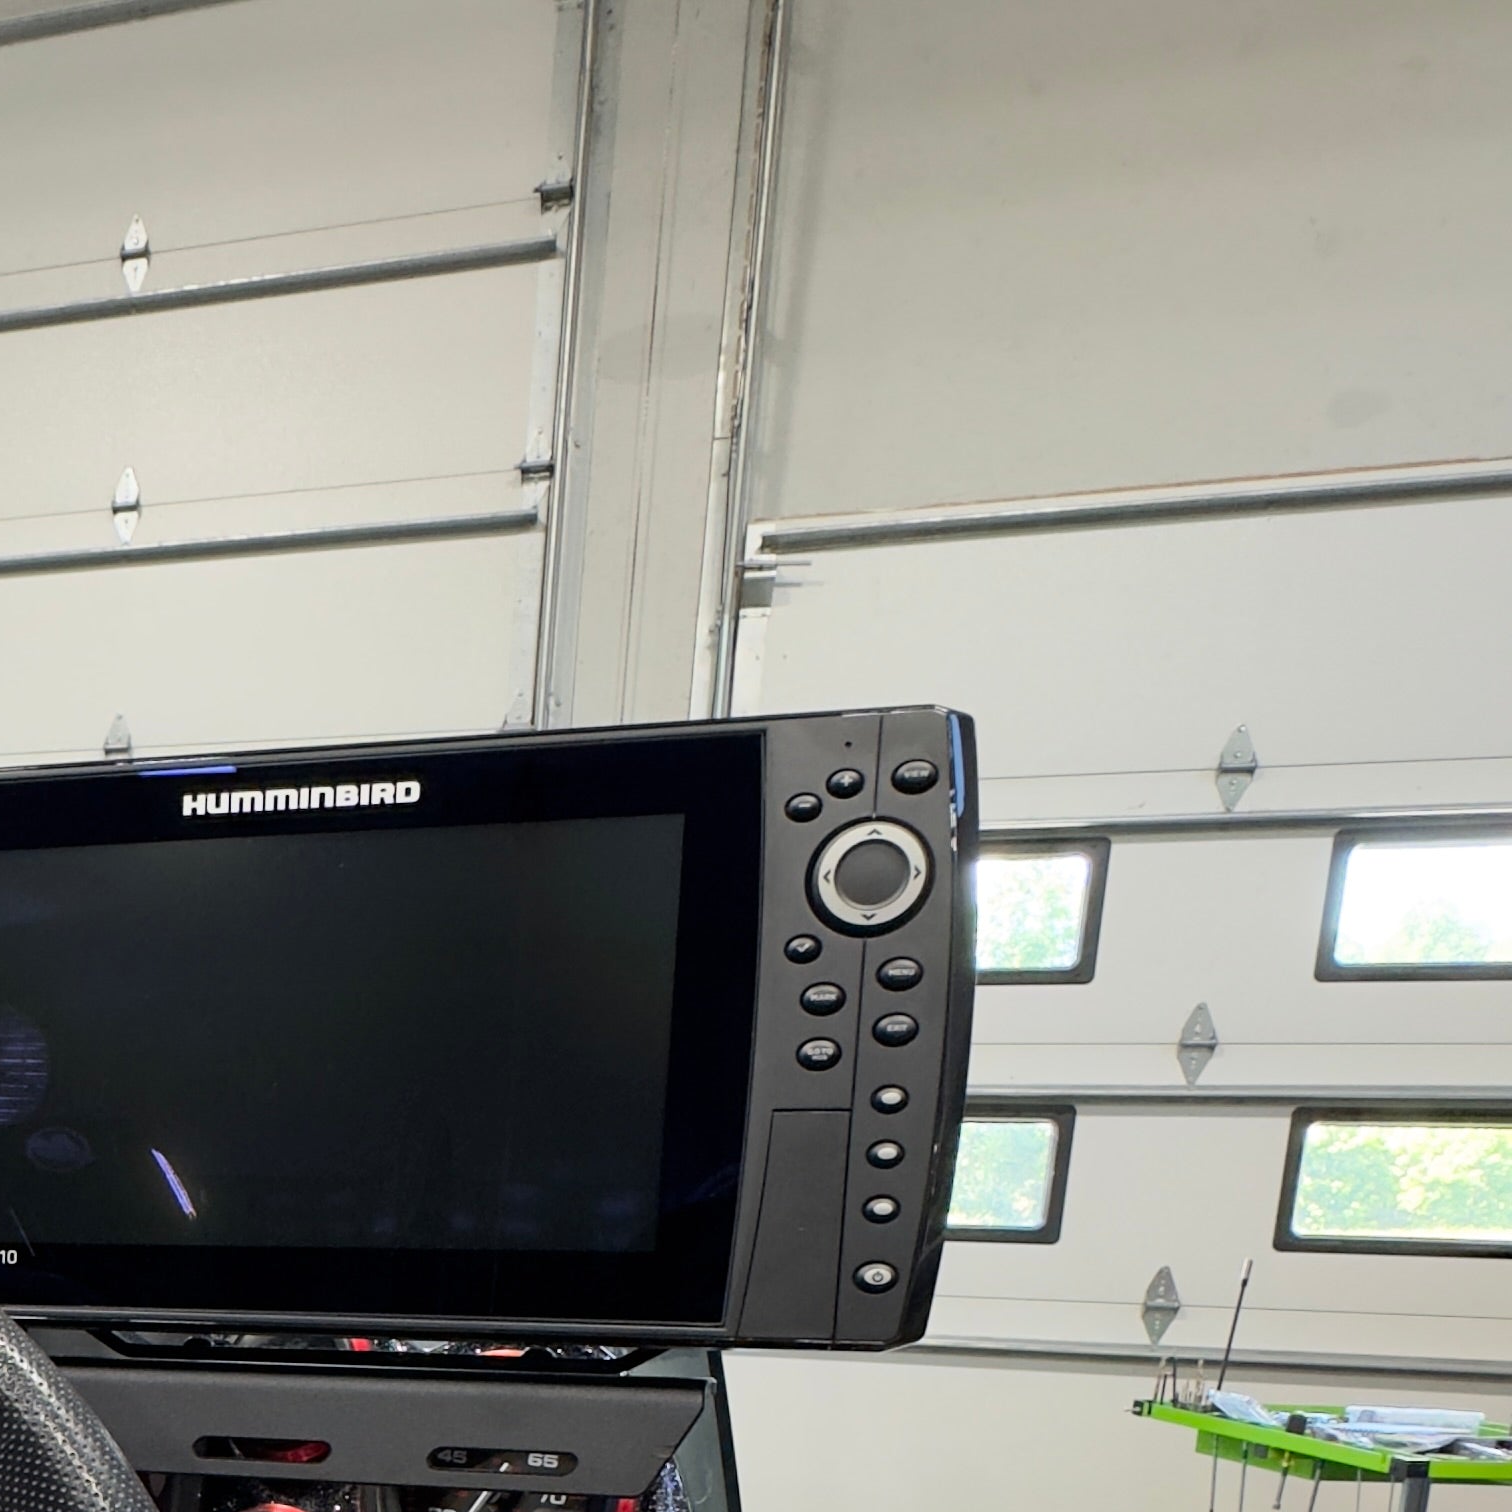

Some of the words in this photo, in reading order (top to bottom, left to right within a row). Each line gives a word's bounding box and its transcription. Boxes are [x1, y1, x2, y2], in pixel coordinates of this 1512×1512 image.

[182, 781, 420, 816] HUMMINBIRD
[0, 1249, 18, 1264] 10
[438, 1450, 467, 1464] 45
[527, 1453, 559, 1469] 65
